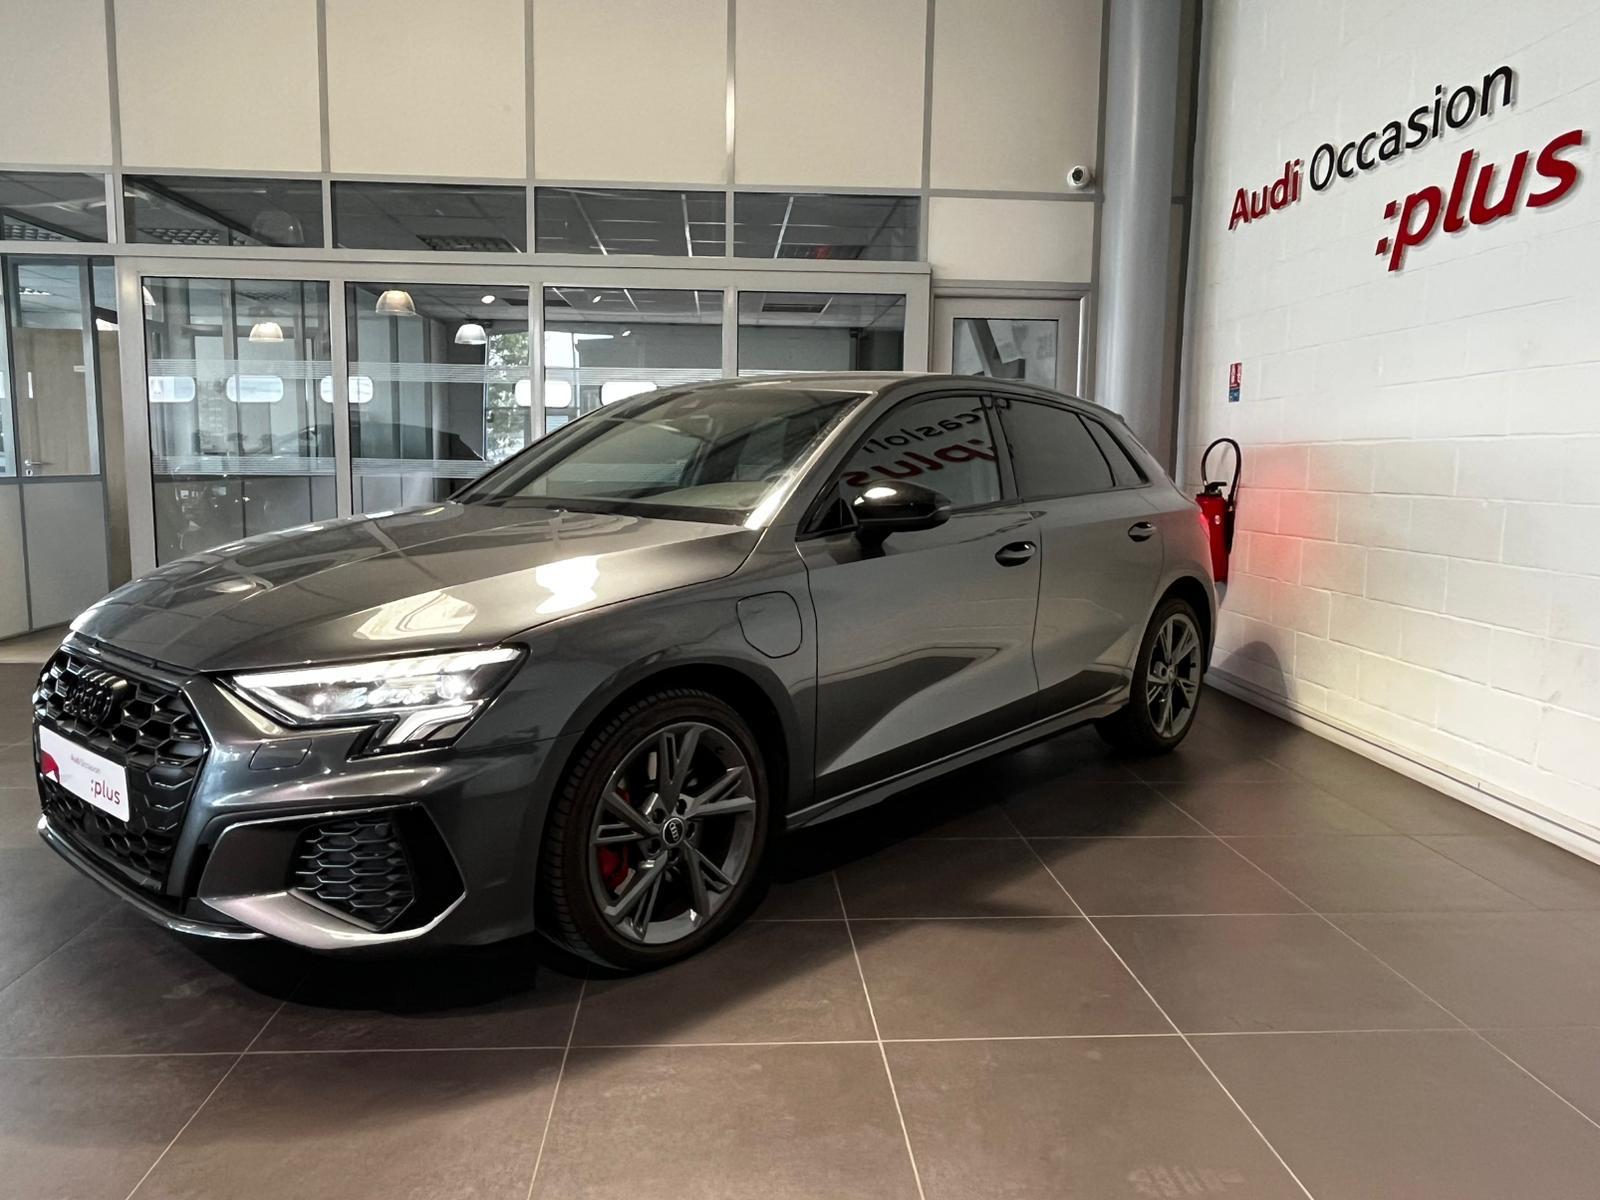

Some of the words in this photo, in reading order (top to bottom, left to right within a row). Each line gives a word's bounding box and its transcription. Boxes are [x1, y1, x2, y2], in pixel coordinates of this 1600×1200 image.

[1228, 158, 1302, 231] Audi
[1308, 65, 1514, 192] Occasion
[1375, 129, 1584, 272] :plus
[91, 779, 121, 805] :plus
